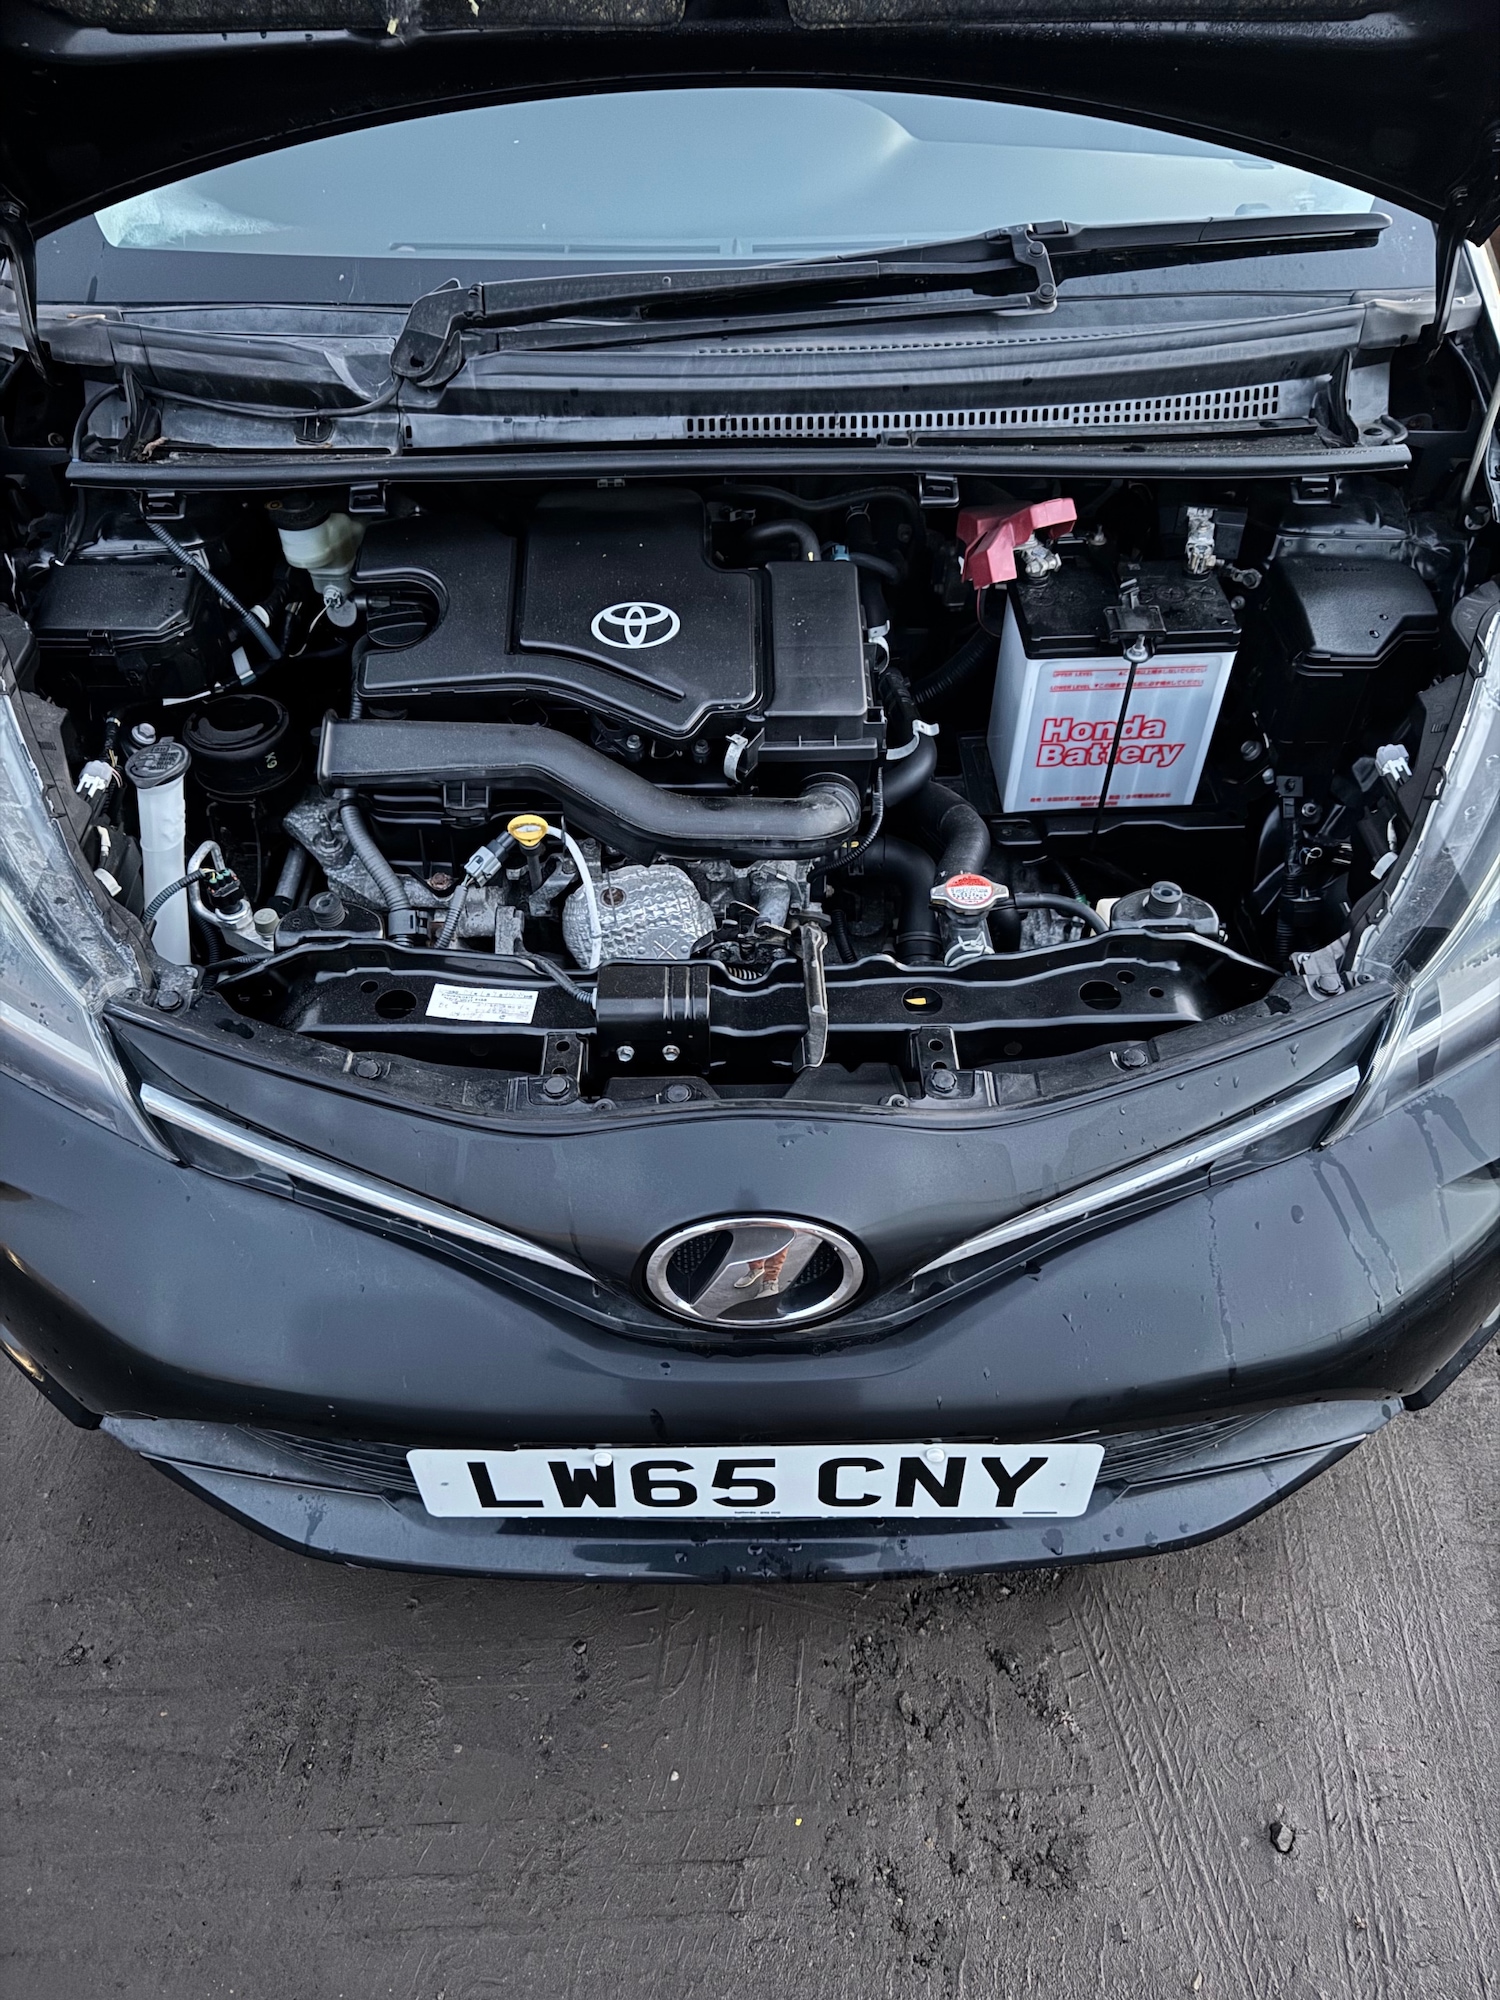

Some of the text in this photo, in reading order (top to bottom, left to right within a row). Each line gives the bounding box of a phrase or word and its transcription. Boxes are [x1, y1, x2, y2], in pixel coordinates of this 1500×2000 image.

[1040, 715, 1166, 743] Honda
[1036, 743, 1186, 768] Battery
[467, 1456, 1049, 1508] LW65 CNY
